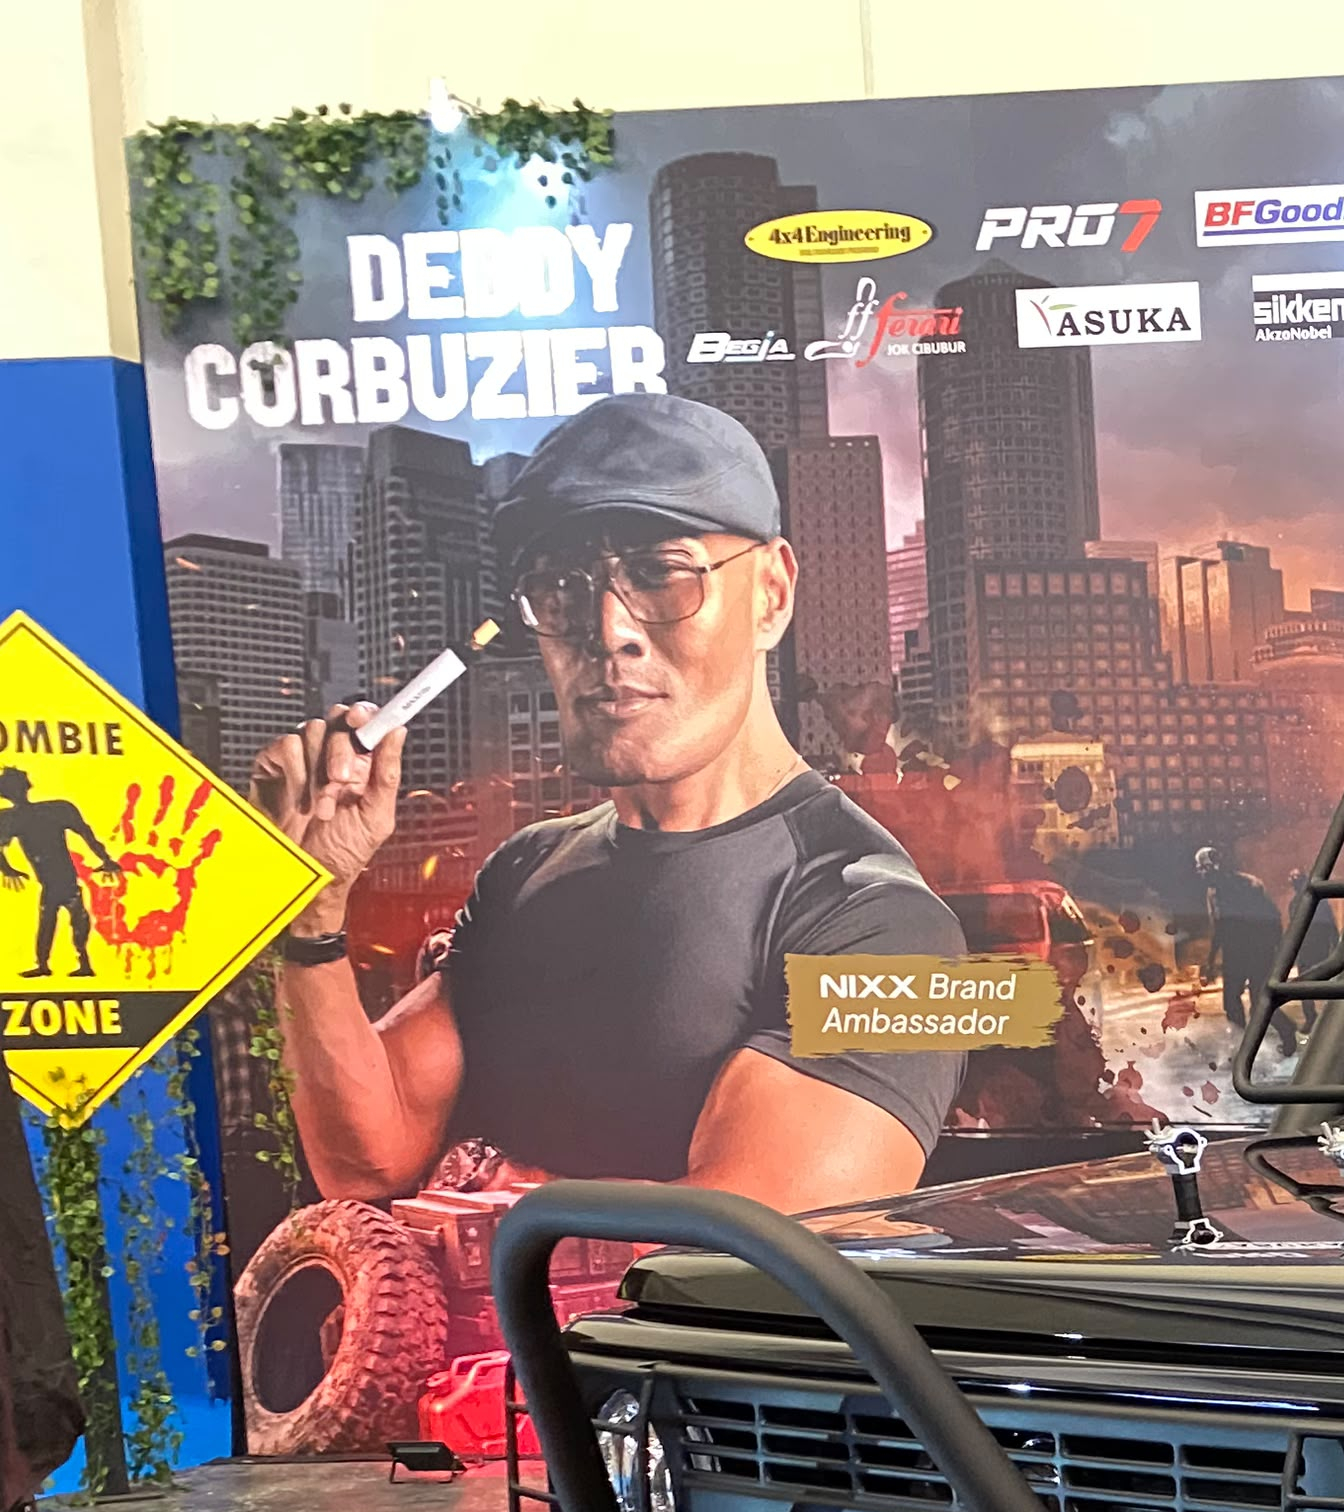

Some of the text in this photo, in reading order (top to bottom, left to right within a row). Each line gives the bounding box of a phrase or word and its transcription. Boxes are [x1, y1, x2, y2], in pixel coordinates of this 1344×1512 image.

[975, 198, 1163, 253] PRO7
[346, 222, 634, 323] DEDDY
[1056, 306, 1192, 337] ASUKA
[1255, 324, 1332, 341] AkzoNobel
[887, 341, 966, 356] JOK CIBUBUR
[184, 325, 668, 431] CORBUZIER
[819, 974, 1017, 1001] NIXX Brand
[3, 999, 122, 1036] ZONE
[821, 1009, 1010, 1036] Ambassador
